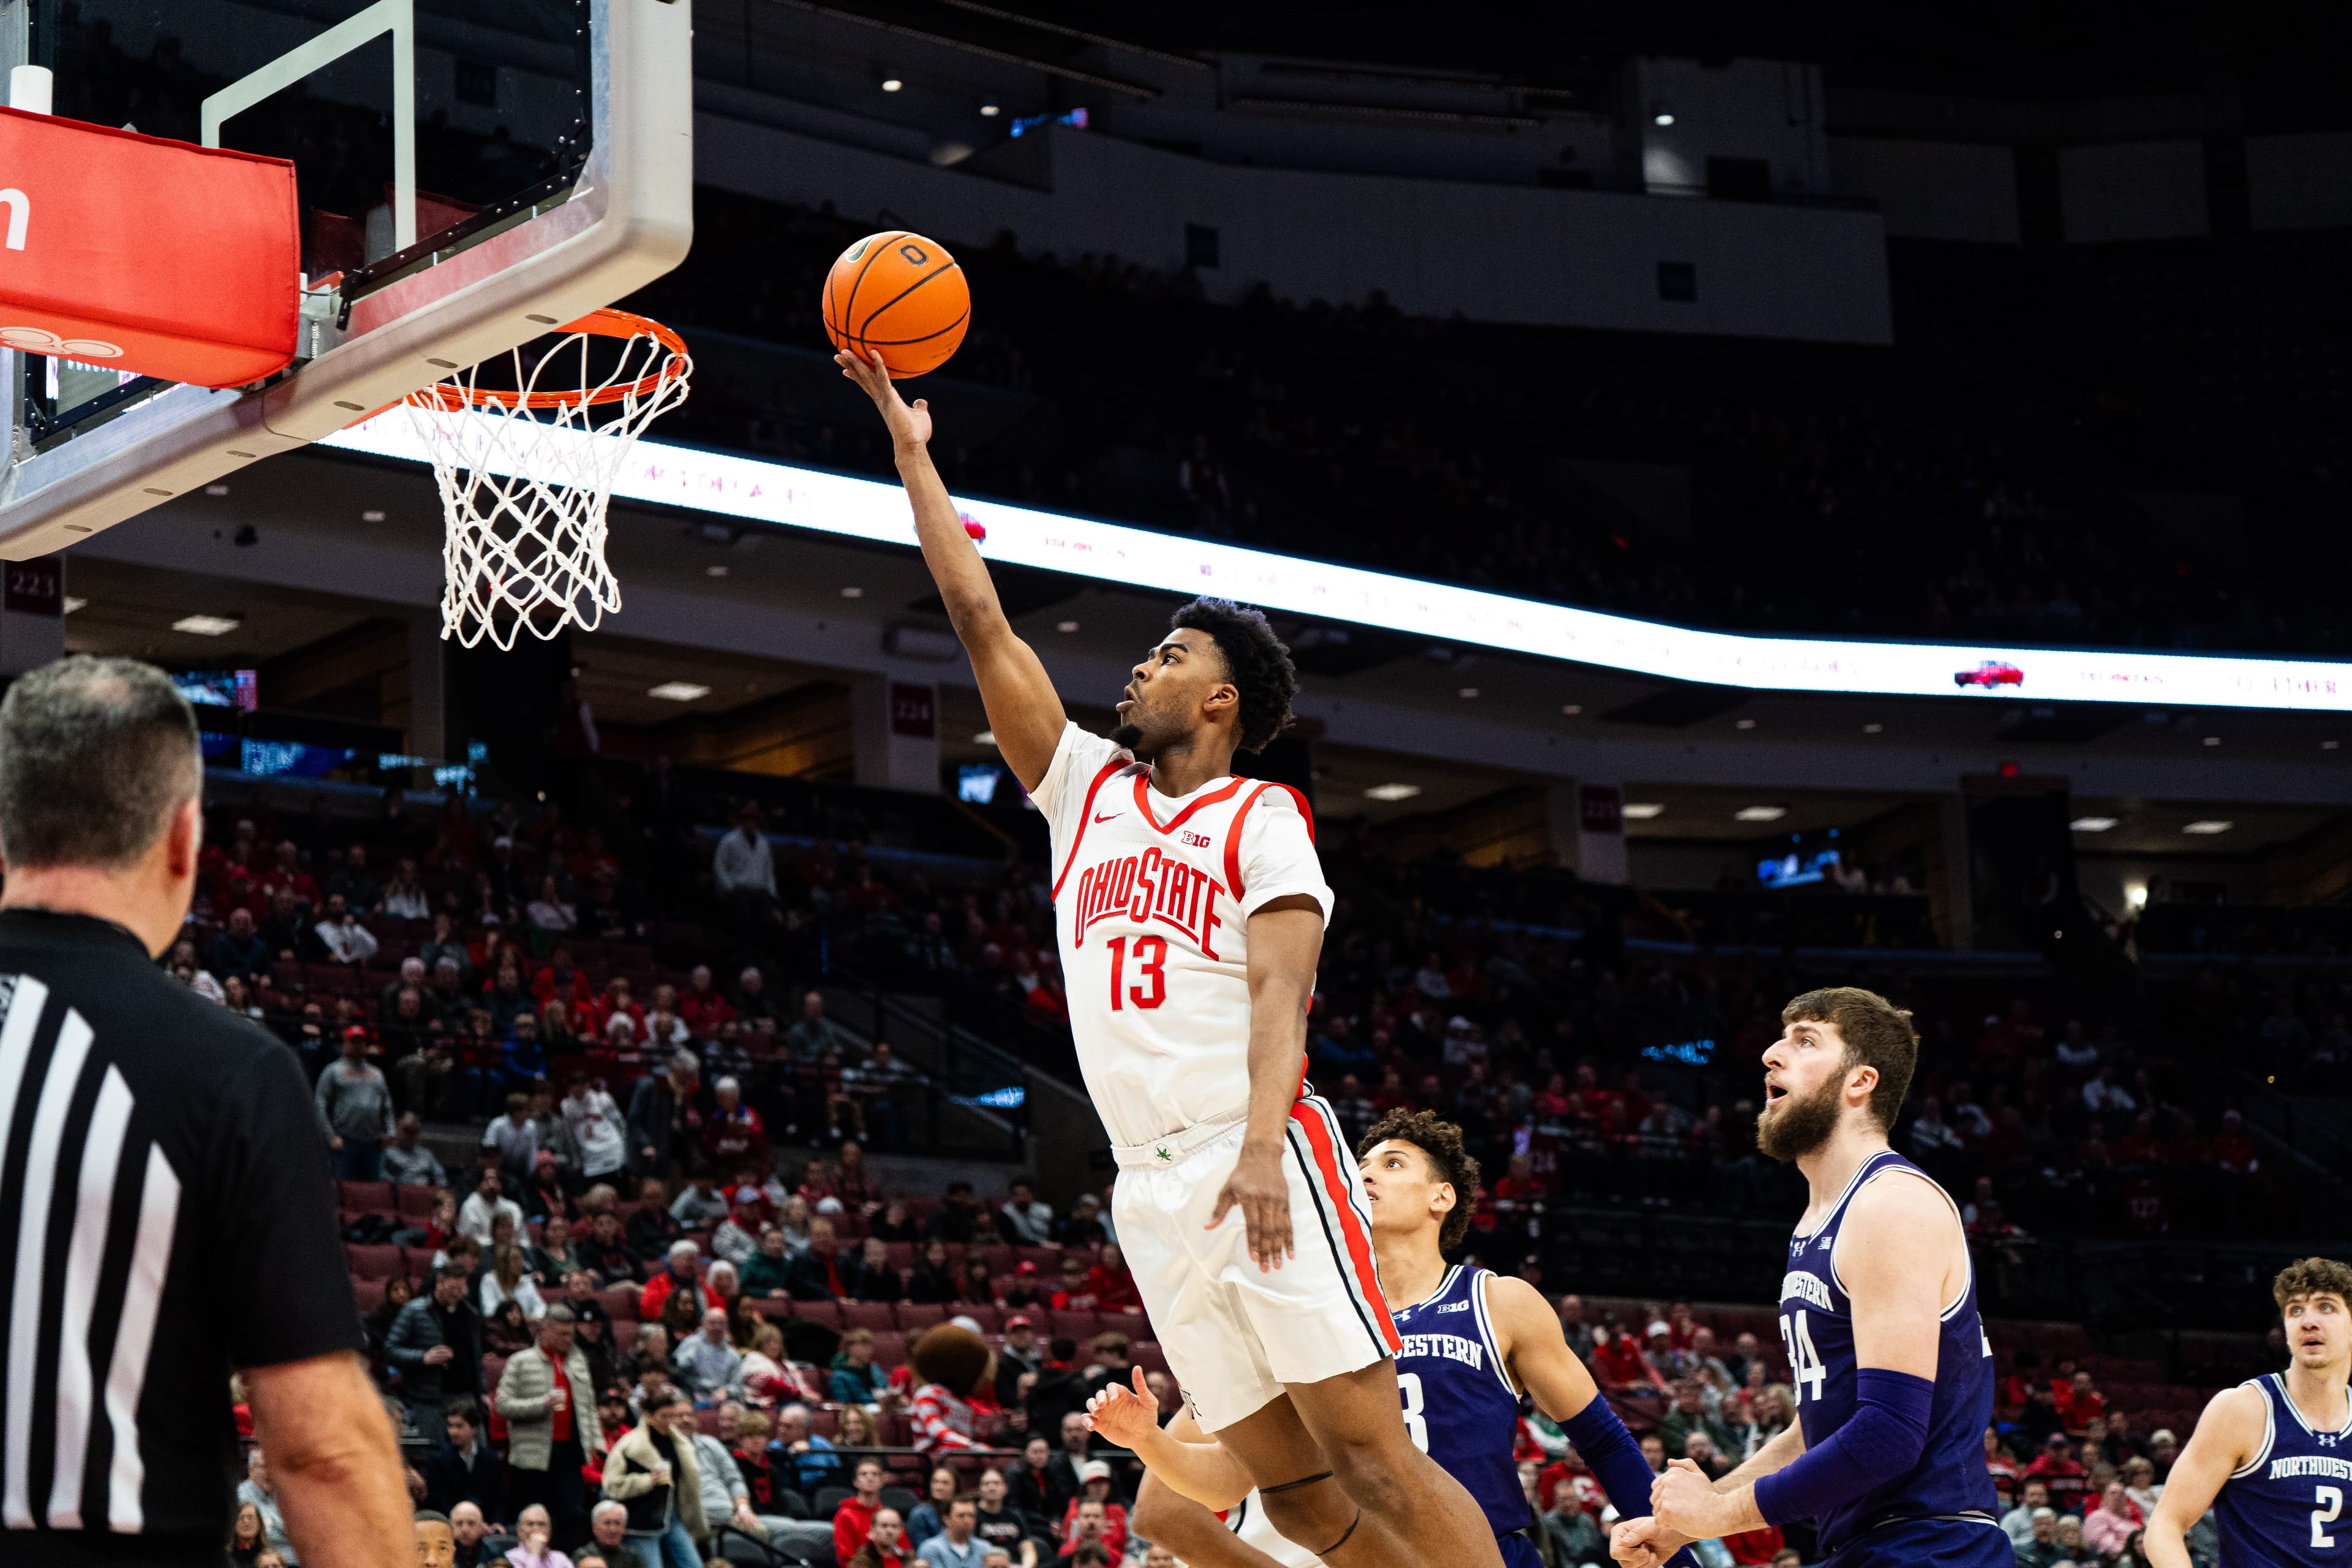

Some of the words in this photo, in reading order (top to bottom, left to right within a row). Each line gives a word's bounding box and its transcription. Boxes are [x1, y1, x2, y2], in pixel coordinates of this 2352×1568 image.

[10, 569, 55, 598] 223
[1106, 935, 1168, 1012] 13
[1779, 1310, 1827, 1408] 34
[2310, 1485, 2343, 1548] 2
